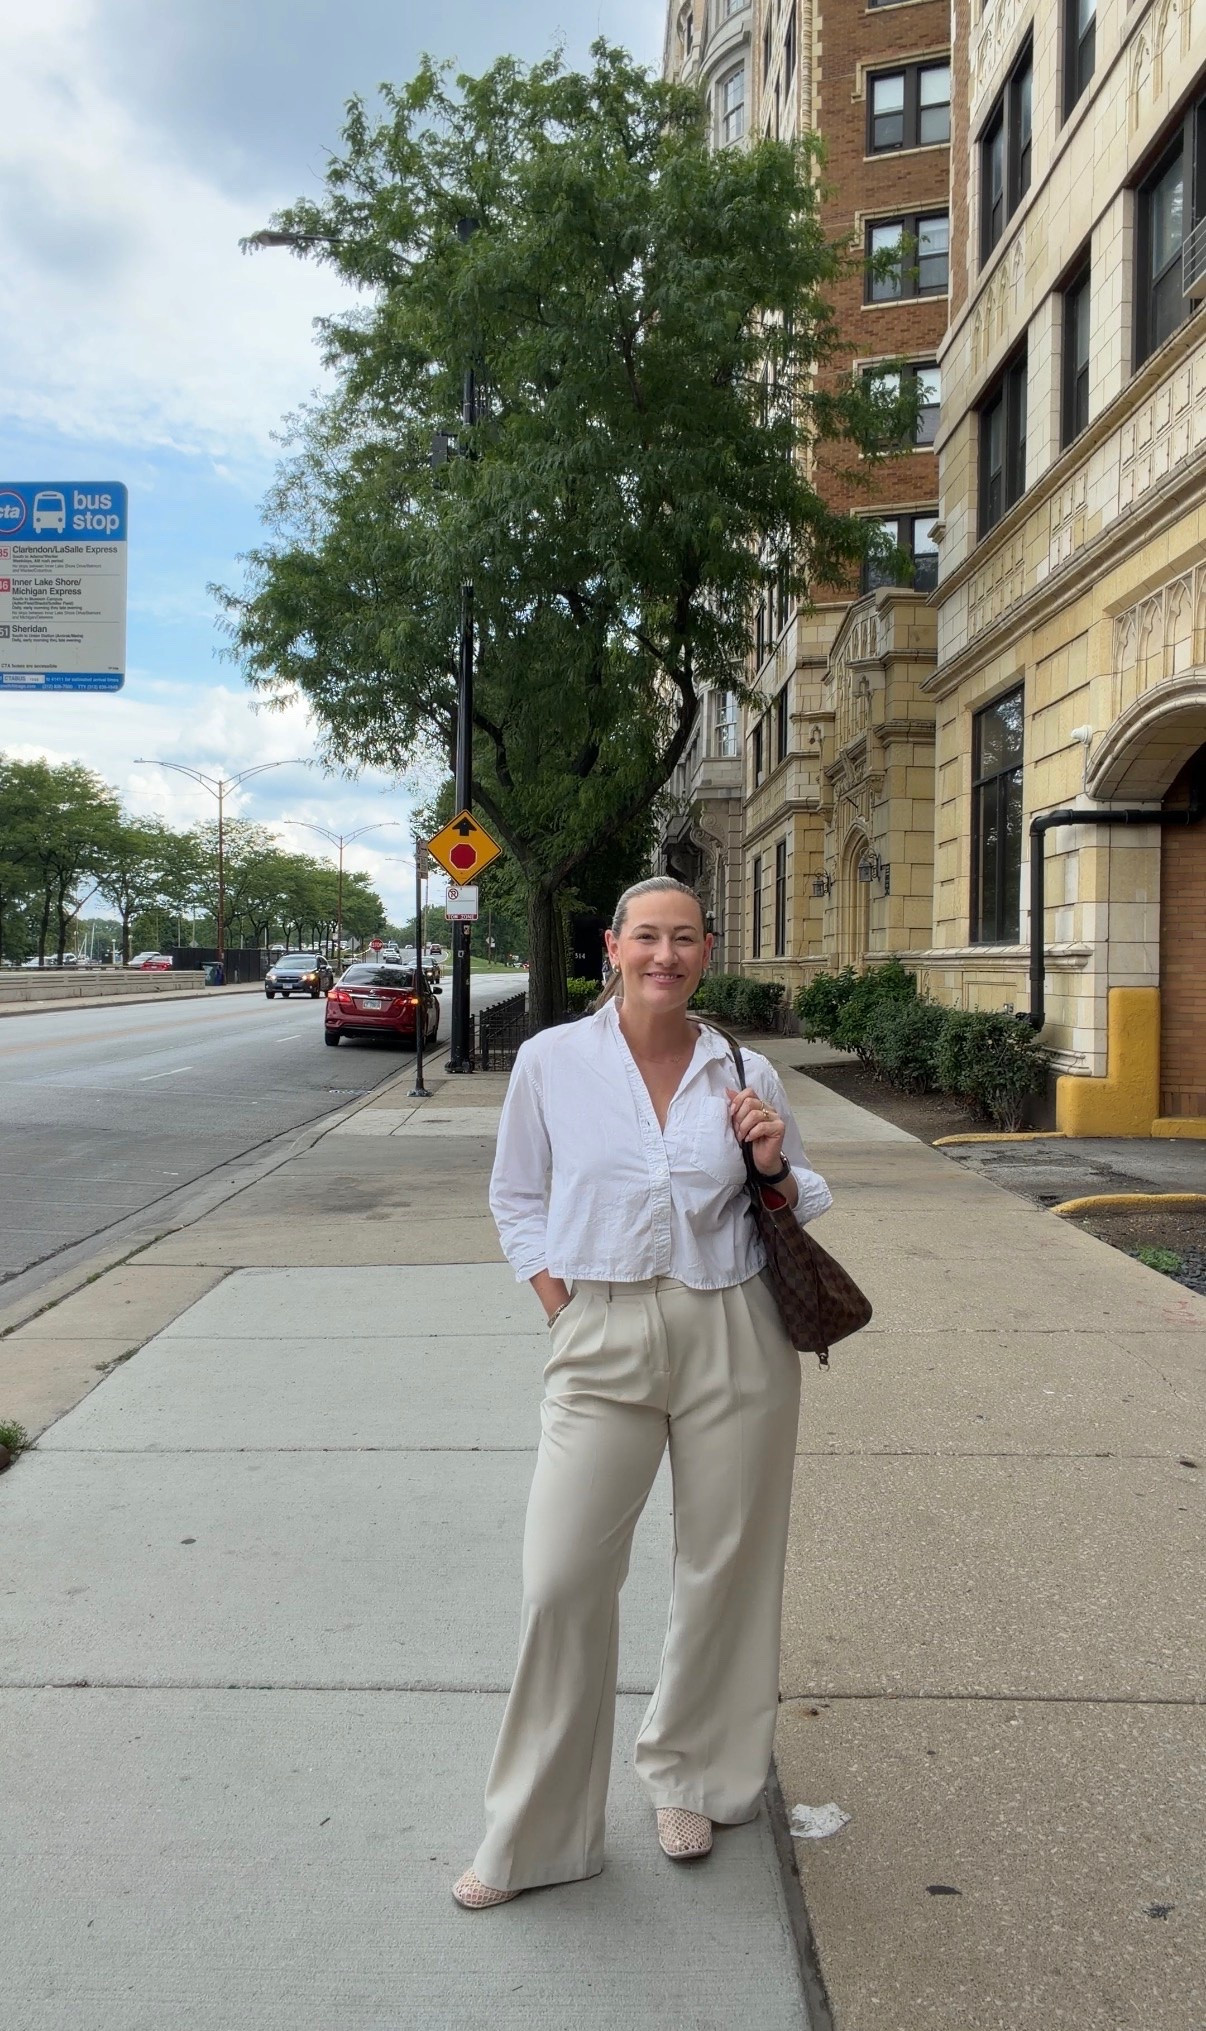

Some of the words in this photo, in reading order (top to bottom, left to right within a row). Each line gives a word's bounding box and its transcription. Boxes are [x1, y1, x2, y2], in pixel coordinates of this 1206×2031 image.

[74, 490, 112, 510] bus
[73, 513, 120, 534] stop
[12, 545, 84, 554] Clarendon/LaSalle
[86, 546, 118, 555] Express
[12, 588, 48, 596] Michigan
[50, 588, 82, 596] Express
[12, 625, 48, 633] Sheridan
